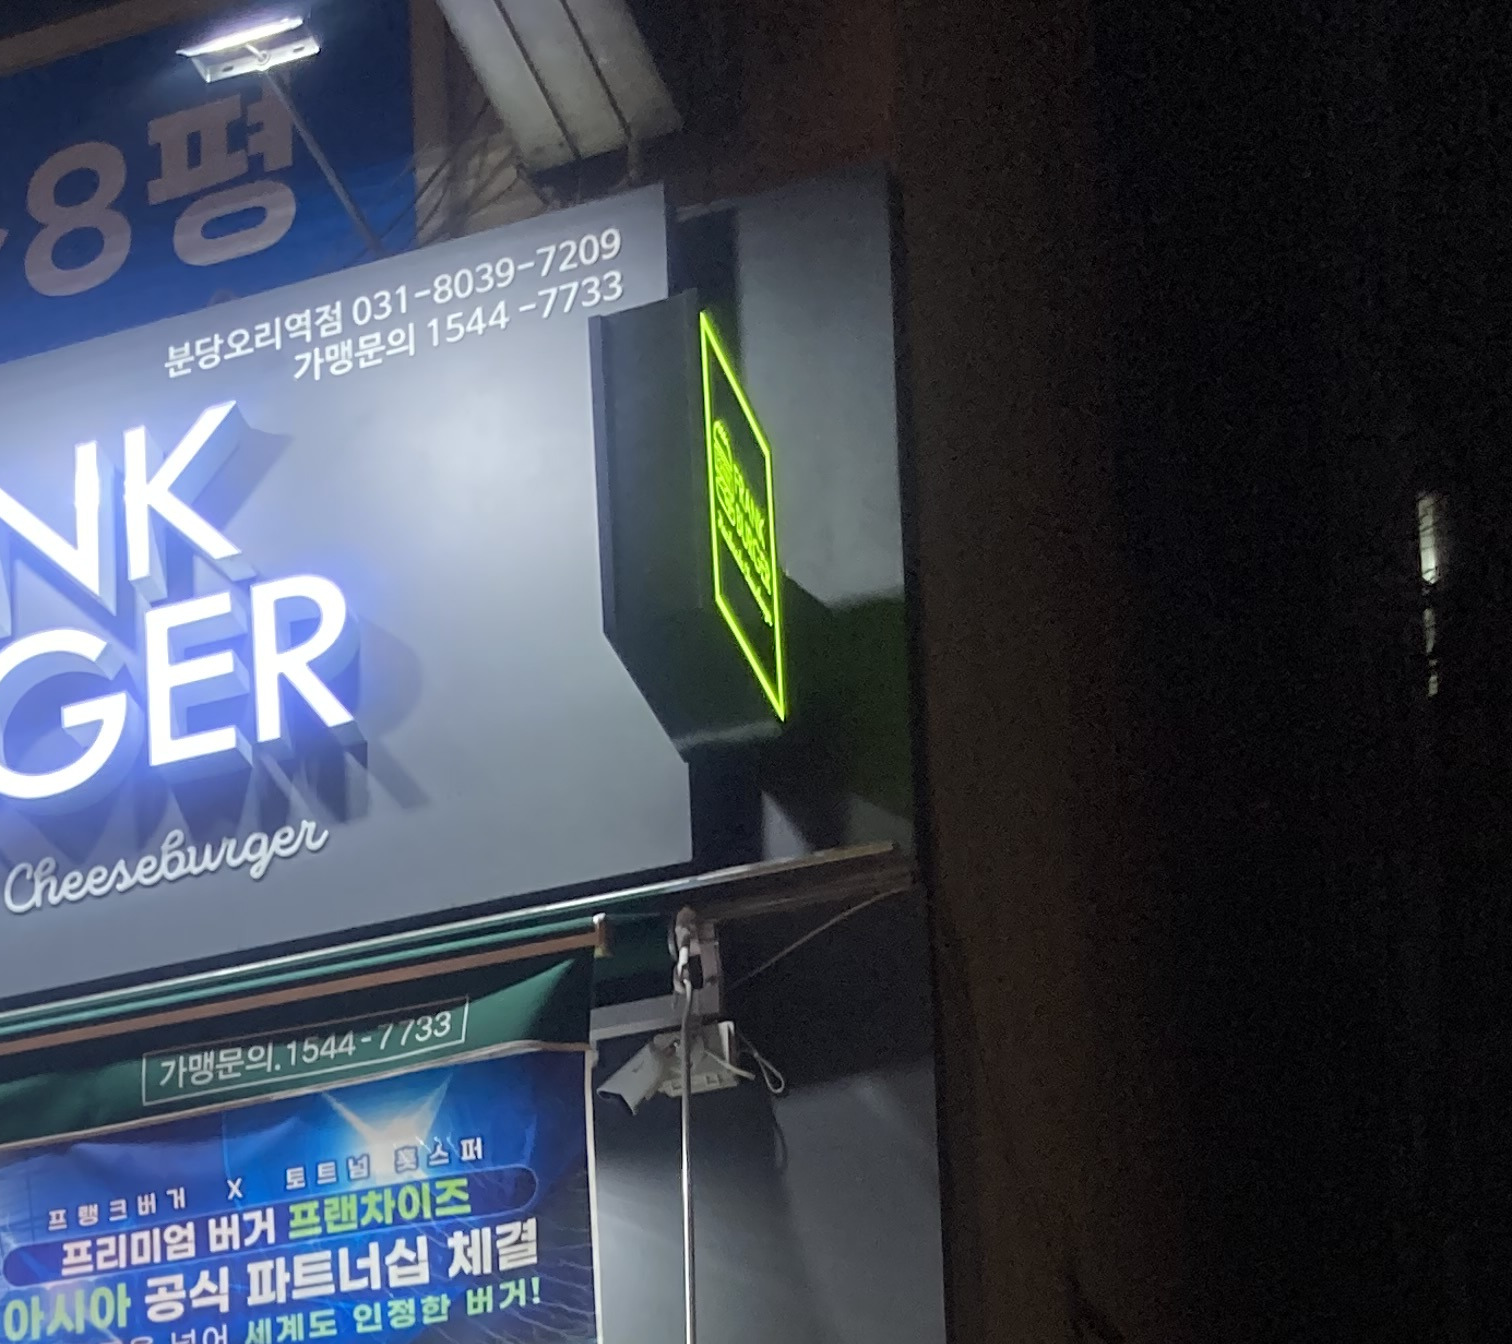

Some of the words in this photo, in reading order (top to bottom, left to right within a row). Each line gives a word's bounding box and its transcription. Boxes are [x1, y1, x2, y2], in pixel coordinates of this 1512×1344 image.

[164, 300, 345, 379] 분당오리역점
[351, 228, 622, 328] 031-8039-7209
[294, 322, 416, 382] 가맹문의
[1, 814, 328, 916] Cheeseburger
[285, 1153, 370, 1190] 토트넘
[61, 1222, 196, 1276] 프리미엄
[208, 1207, 276, 1251] 버거
[288, 1178, 472, 1240] 프랜차이즈
[3, 1283, 131, 1342] 아시아
[144, 1266, 231, 1323] 공식
[247, 1235, 430, 1306] 파트너십
[448, 1217, 538, 1278] 체결
[352, 1292, 451, 1335] 인정한
[466, 1276, 541, 1316] 버거!
